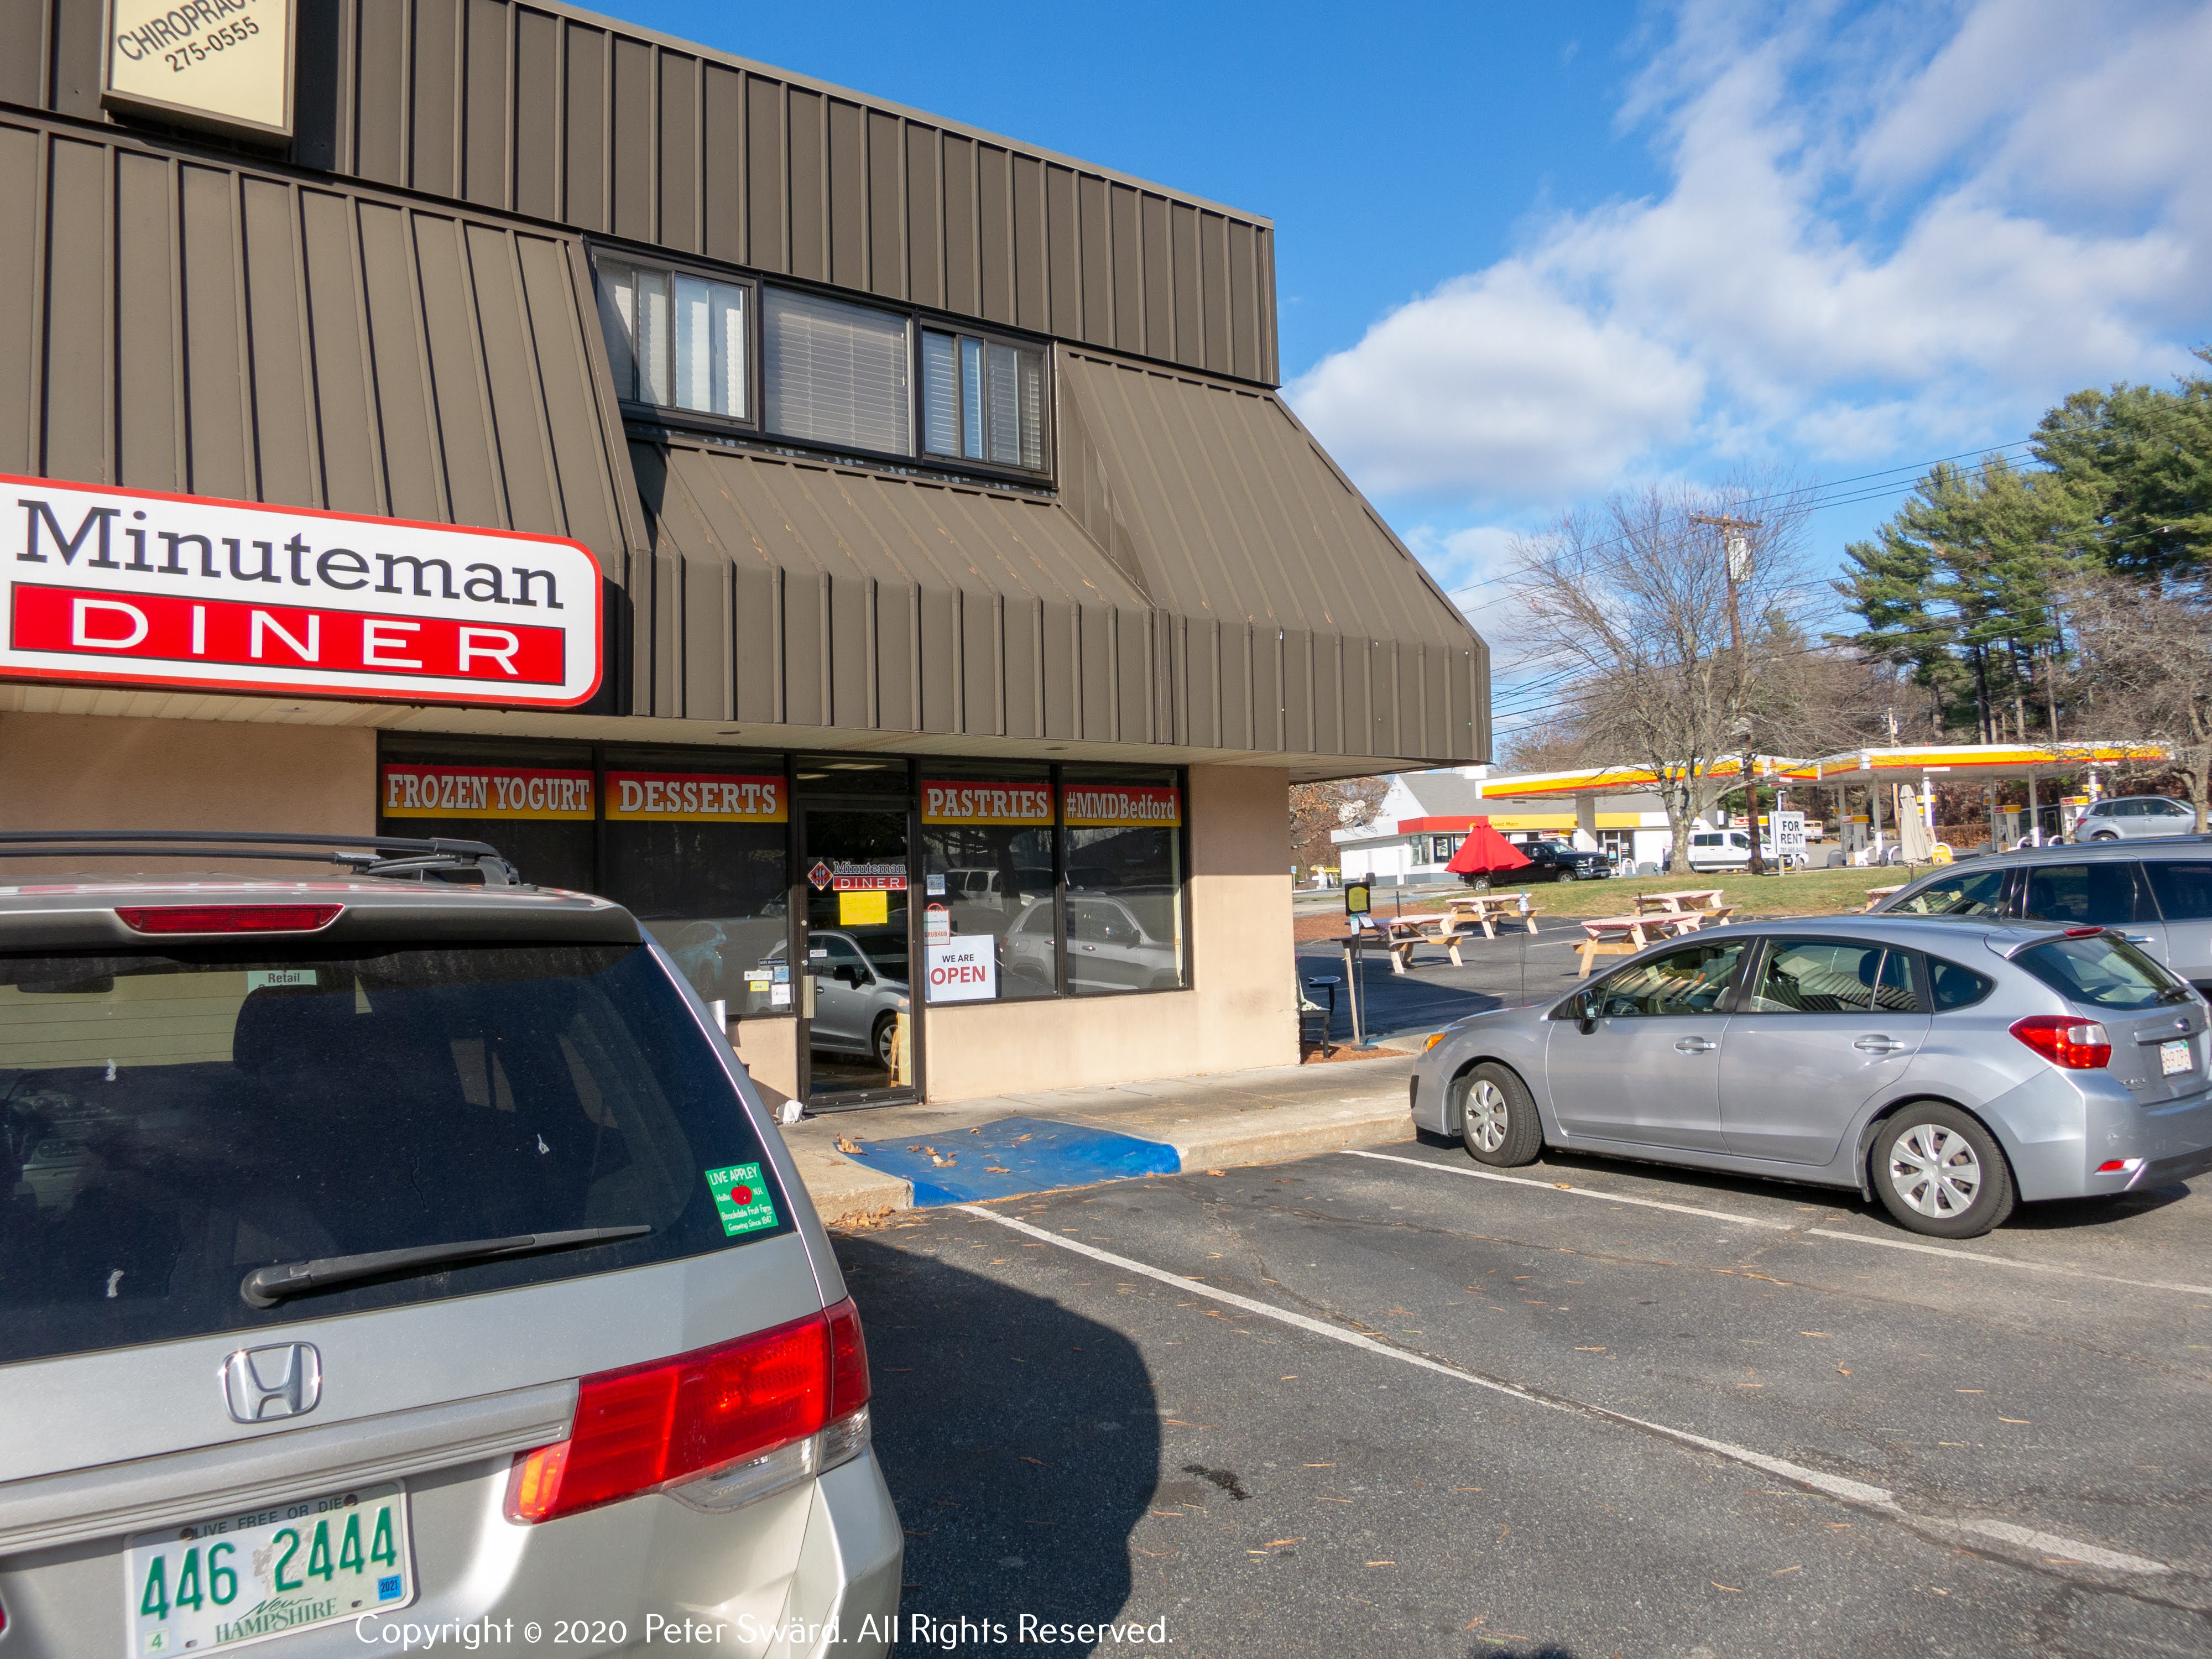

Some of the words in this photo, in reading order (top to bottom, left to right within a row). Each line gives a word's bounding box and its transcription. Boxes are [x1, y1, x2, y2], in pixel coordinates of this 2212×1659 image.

[165, 16, 259, 72] 275-0555
[16, 499, 564, 609] Minuteman
[72, 598, 519, 675] DINER
[388, 774, 489, 810] FROZEN
[494, 776, 589, 811] YOGURT
[619, 780, 776, 815] DESSERTS
[927, 788, 1048, 818] PASTRIES
[1066, 792, 1176, 821] #MMDBedford
[1782, 821, 1799, 831] FOR
[1781, 833, 1803, 844] RENT
[833, 862, 907, 874] Minuteman
[841, 878, 900, 888] DINER
[942, 954, 955, 963] WE
[957, 954, 974, 962] ARE
[268, 973, 300, 983] Retail
[931, 966, 985, 985] OPEN
[709, 1171, 728, 1185] LIVE
[729, 1166, 757, 1181] APPLEY
[748, 1206, 759, 1215] Fruit
[759, 1204, 772, 1213] Farm
[195, 1521, 227, 1539] LIVE
[238, 1511, 278, 1530] FREE
[287, 1505, 309, 1520] OR
[319, 1498, 343, 1512] DIE
[140, 1541, 238, 1621] 446
[272, 1507, 397, 1593] 2444
[380, 1579, 398, 1593] 2021
[237, 1596, 313, 1621] New
[215, 1598, 338, 1644] HAMPSHIRE
[152, 1633, 163, 1647] 4
